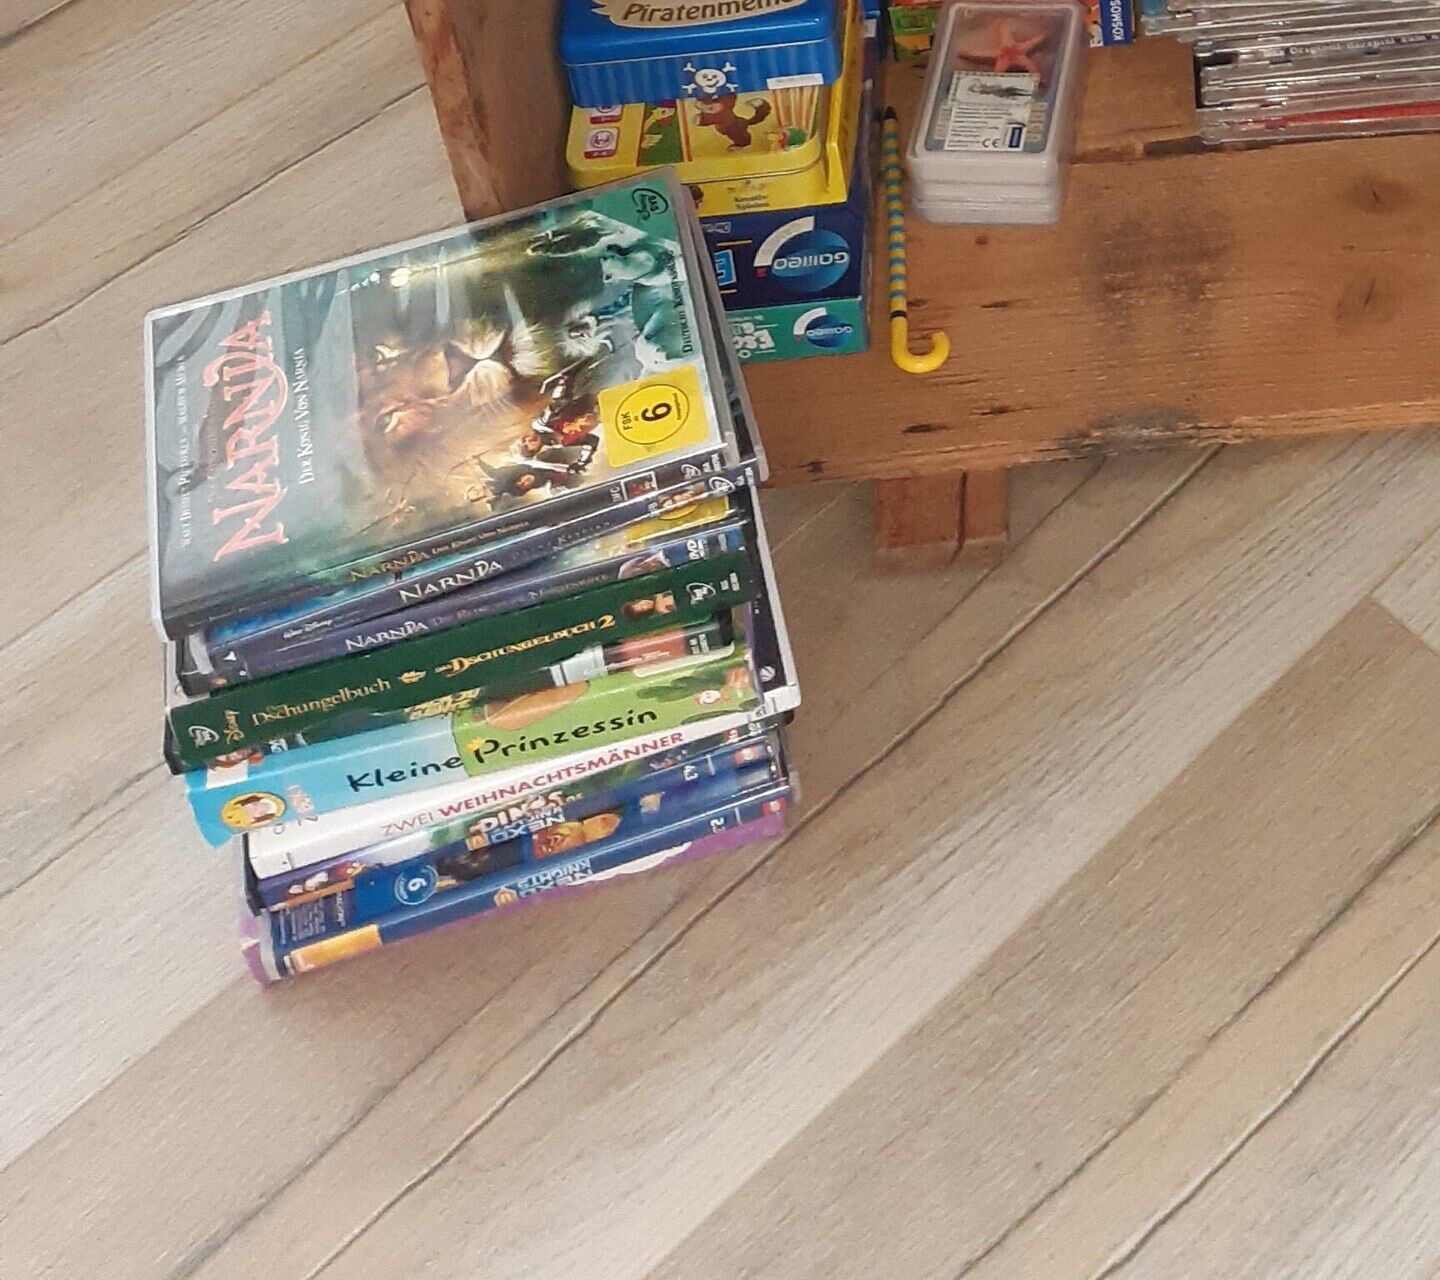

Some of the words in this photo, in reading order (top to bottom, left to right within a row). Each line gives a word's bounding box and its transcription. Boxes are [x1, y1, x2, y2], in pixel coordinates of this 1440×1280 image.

[1113, 0, 1124, 41] KOSMOS
[292, 347, 308, 392] NARNIA
[622, 411, 633, 431] FSK
[641, 402, 673, 422] 6
[203, 308, 289, 562] NARNIA
[399, 558, 503, 603] NARNIA
[345, 620, 429, 650] NARNIA
[598, 614, 617, 631] 2
[251, 676, 392, 728] Dschungelbuch
[345, 754, 464, 793] Kleine
[473, 708, 658, 765] Prinzessin
[380, 810, 436, 837] ZWEI
[436, 731, 685, 818] WEIHNACHTSMÄNNER
